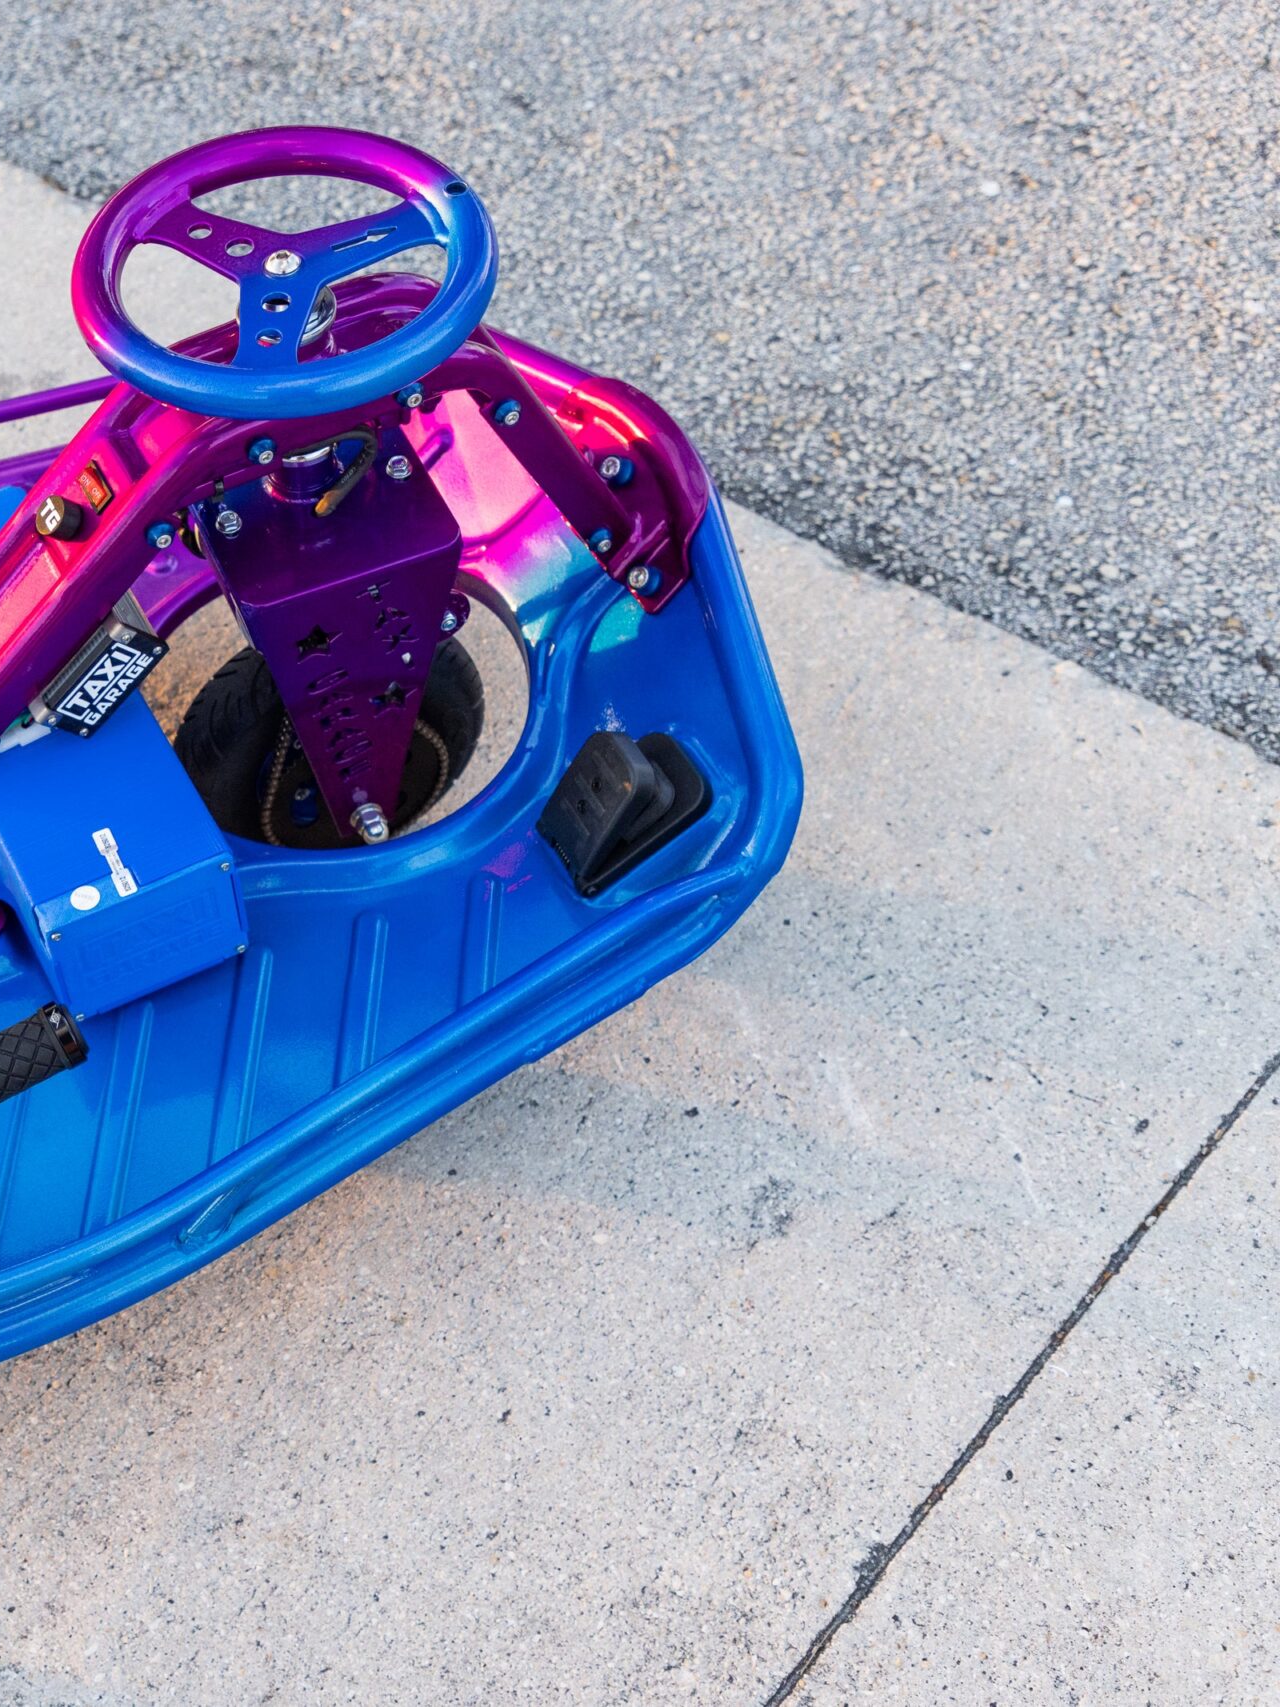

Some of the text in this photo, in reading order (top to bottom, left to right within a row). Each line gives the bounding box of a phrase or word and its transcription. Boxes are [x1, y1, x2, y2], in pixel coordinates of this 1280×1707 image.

[40, 497, 61, 532] TG
[65, 649, 131, 709] TAXI
[84, 653, 154, 726] GARAGE
